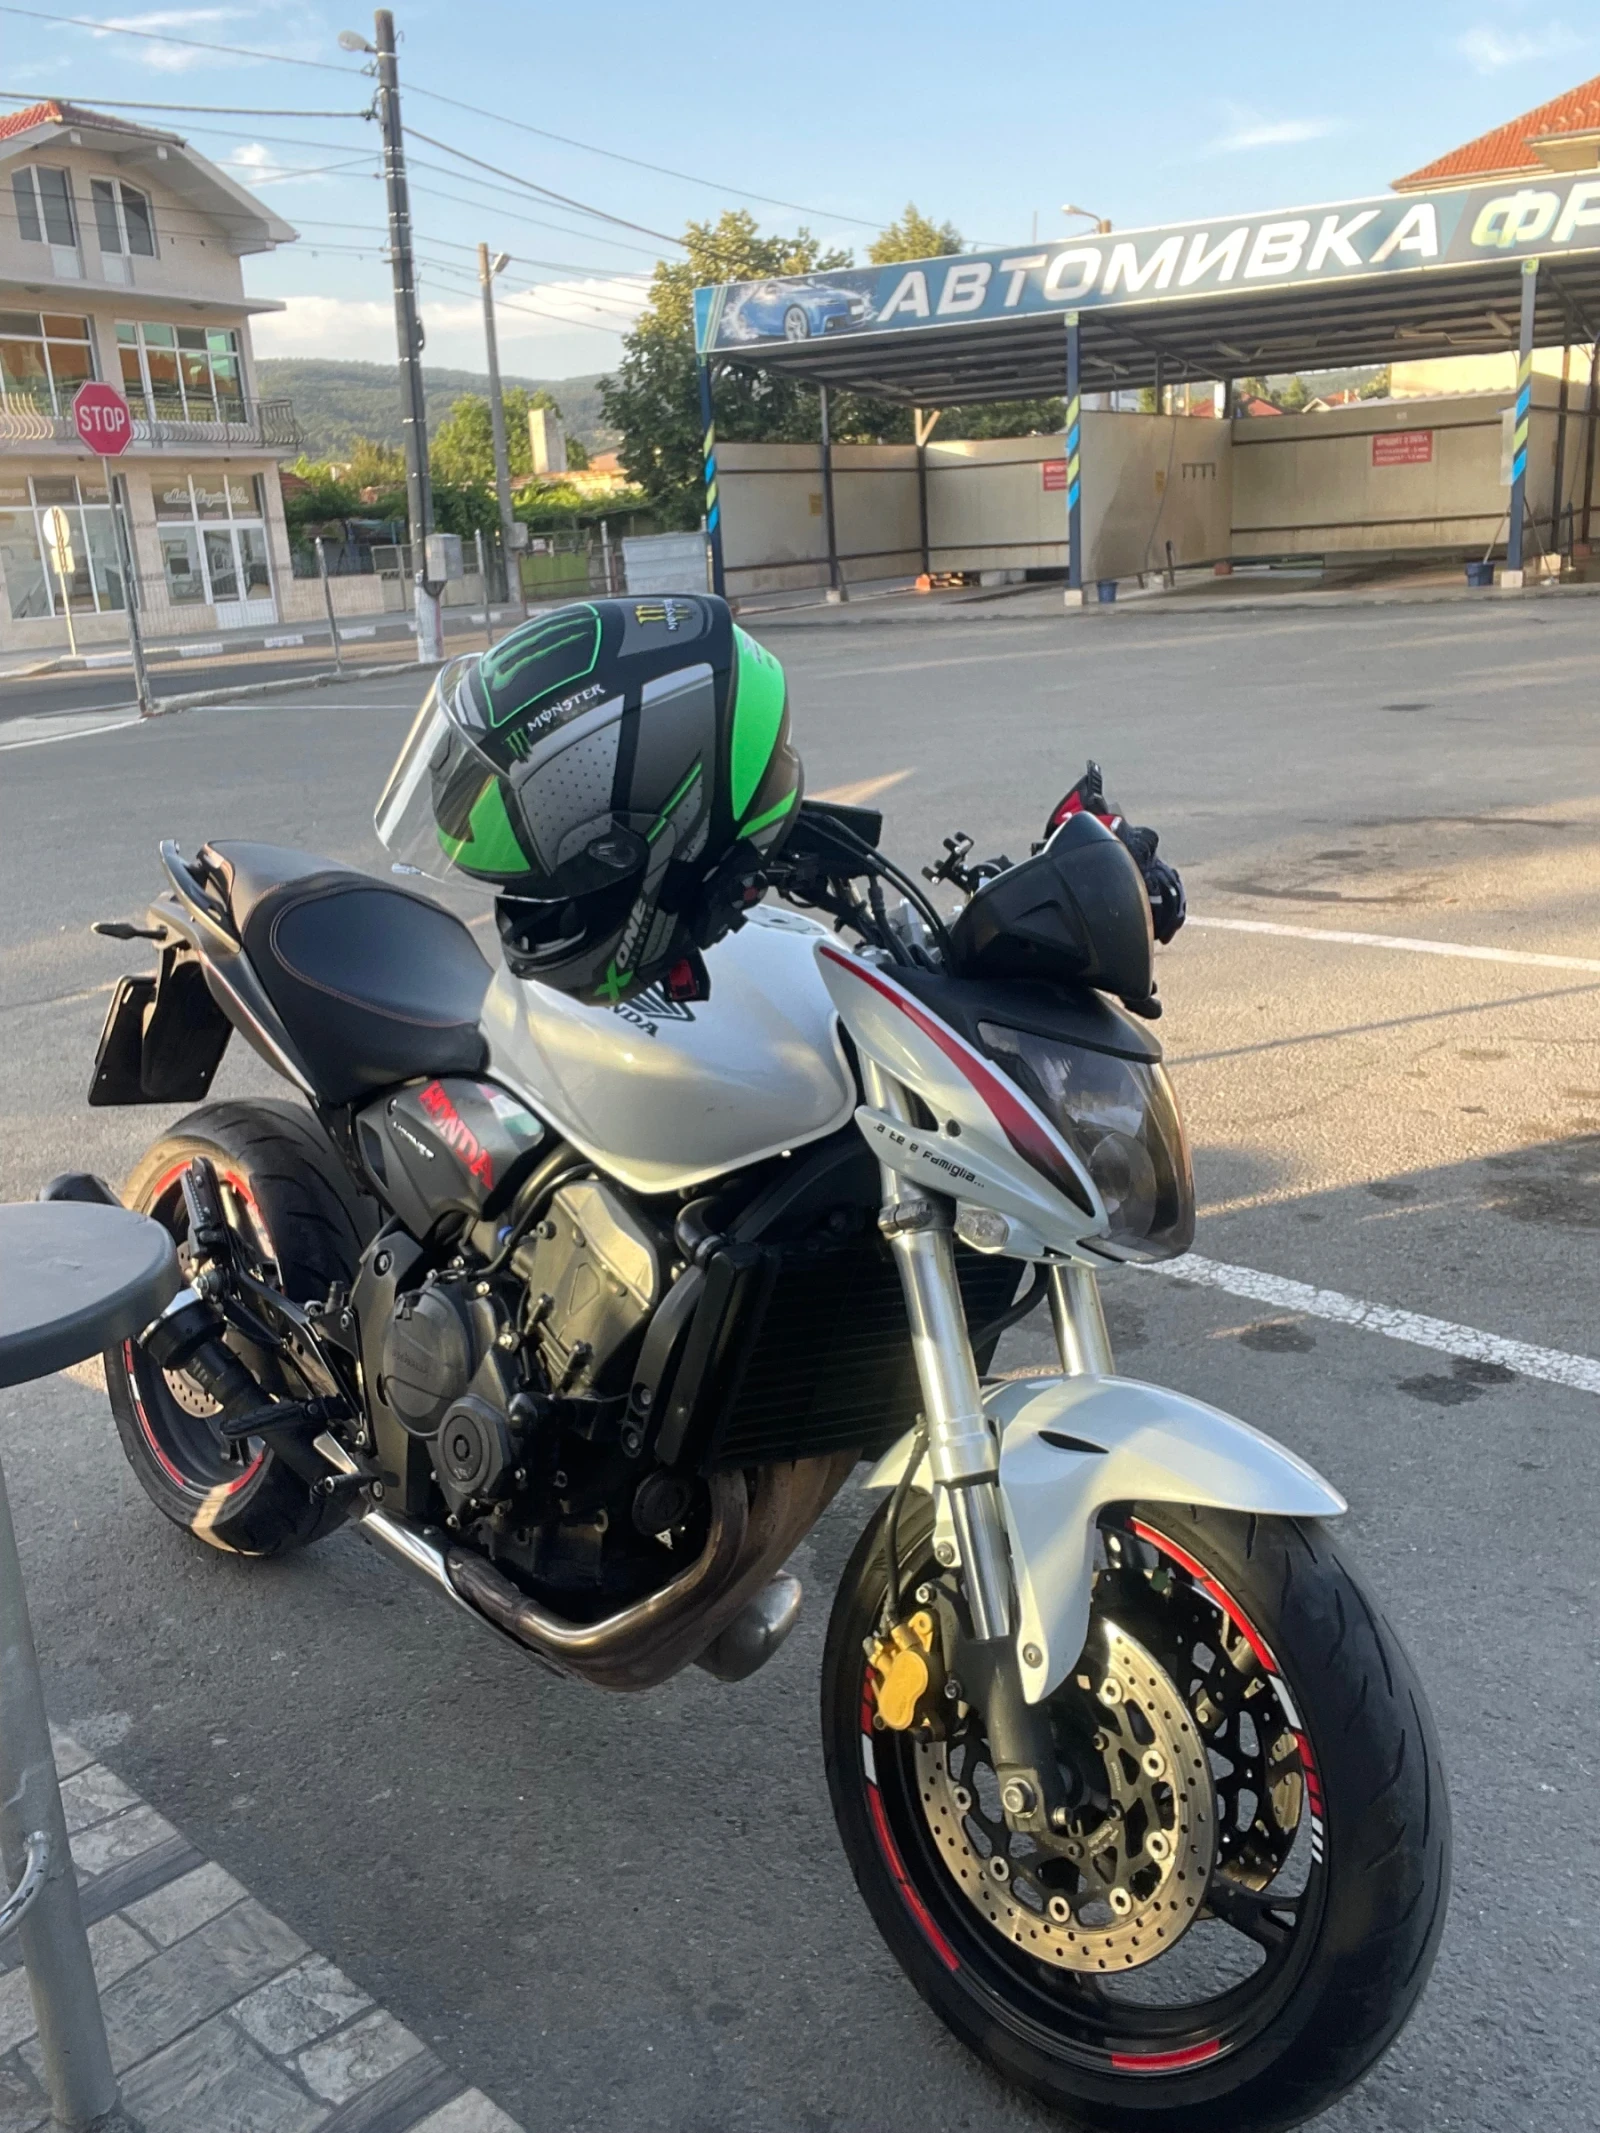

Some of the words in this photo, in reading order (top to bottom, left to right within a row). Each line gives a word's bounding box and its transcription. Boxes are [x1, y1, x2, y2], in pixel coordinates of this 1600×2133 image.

[876, 203, 1438, 322] АВТОМИВКА
[79, 405, 125, 432] STOP
[605, 1003, 660, 1038] NDA
[418, 1079, 494, 1192] HONDA
